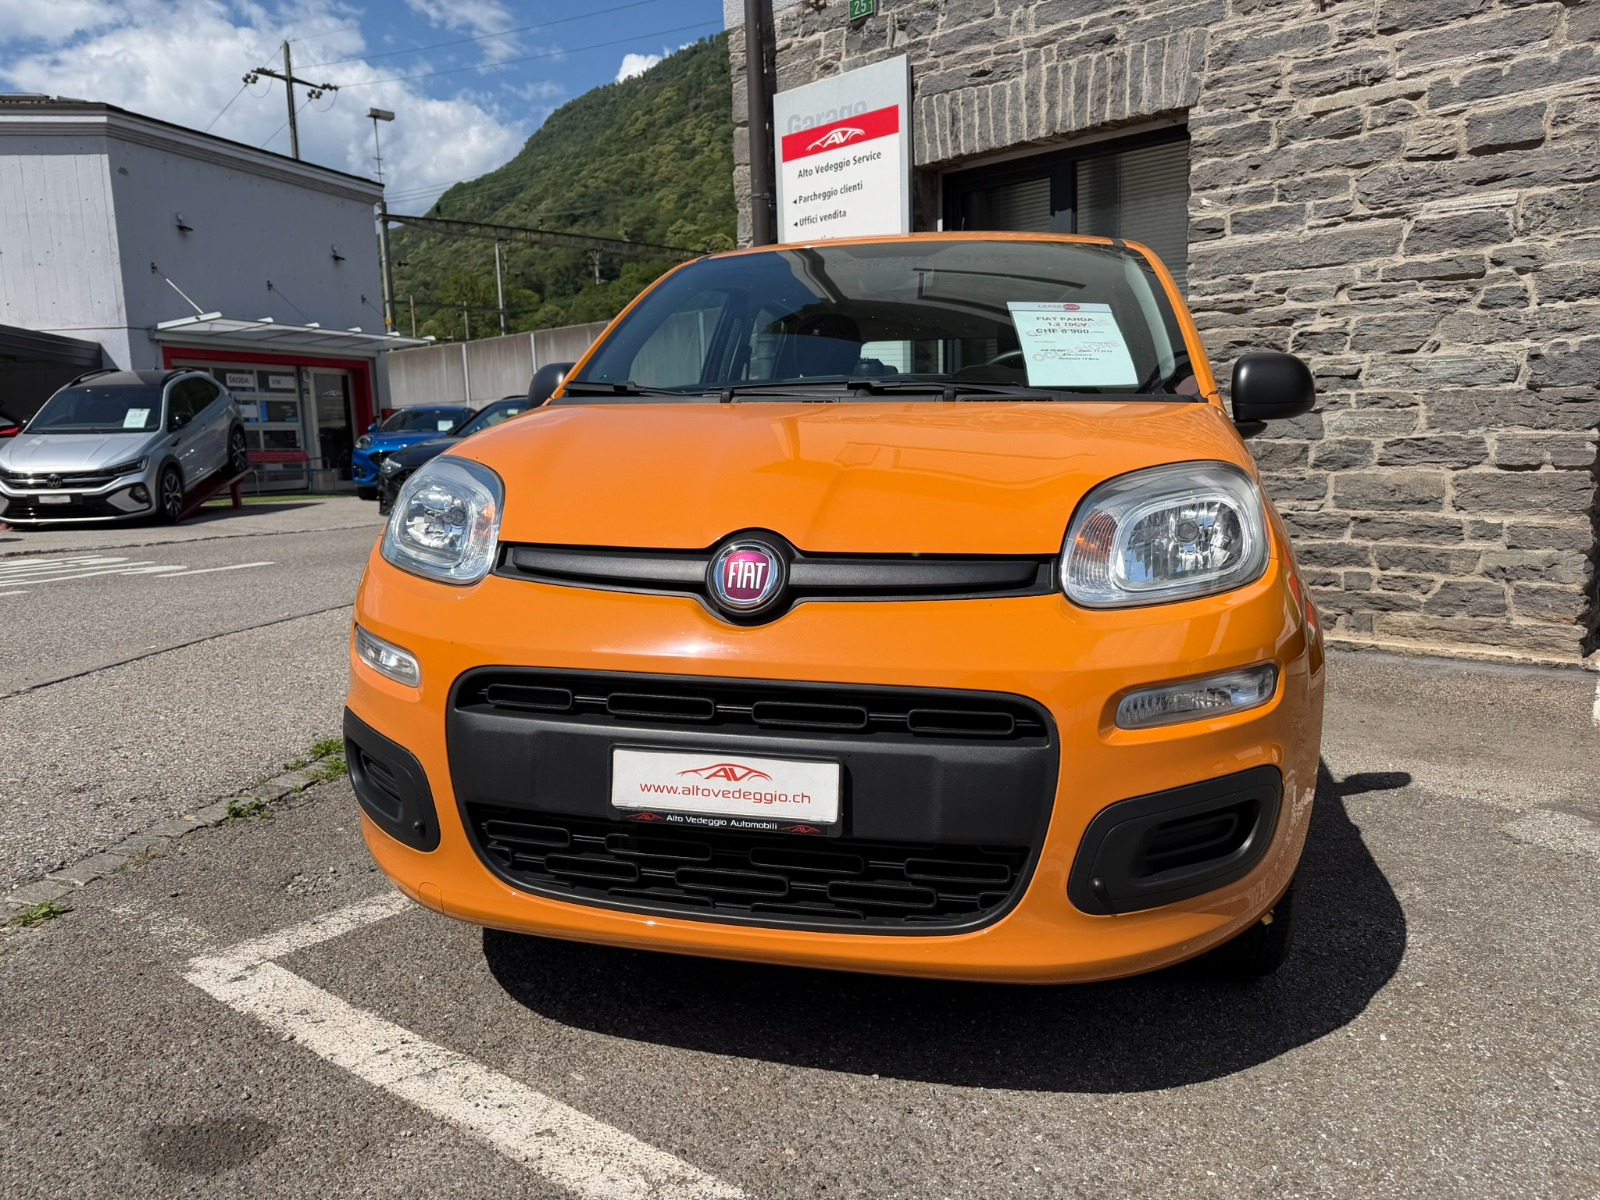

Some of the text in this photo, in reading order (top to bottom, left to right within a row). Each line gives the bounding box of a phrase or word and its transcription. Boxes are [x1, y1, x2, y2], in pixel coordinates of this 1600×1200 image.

[854, 0, 867, 15] 25
[798, 150, 882, 179] Alto Vedeggio Service
[798, 180, 863, 204] Parcheggio clienti
[799, 209, 847, 227] Uffici vendita
[727, 560, 767, 590] FIAT
[640, 783, 811, 804] www.altovedeggio.ch
[666, 814, 778, 830] Alto Vedeggio Automobili
